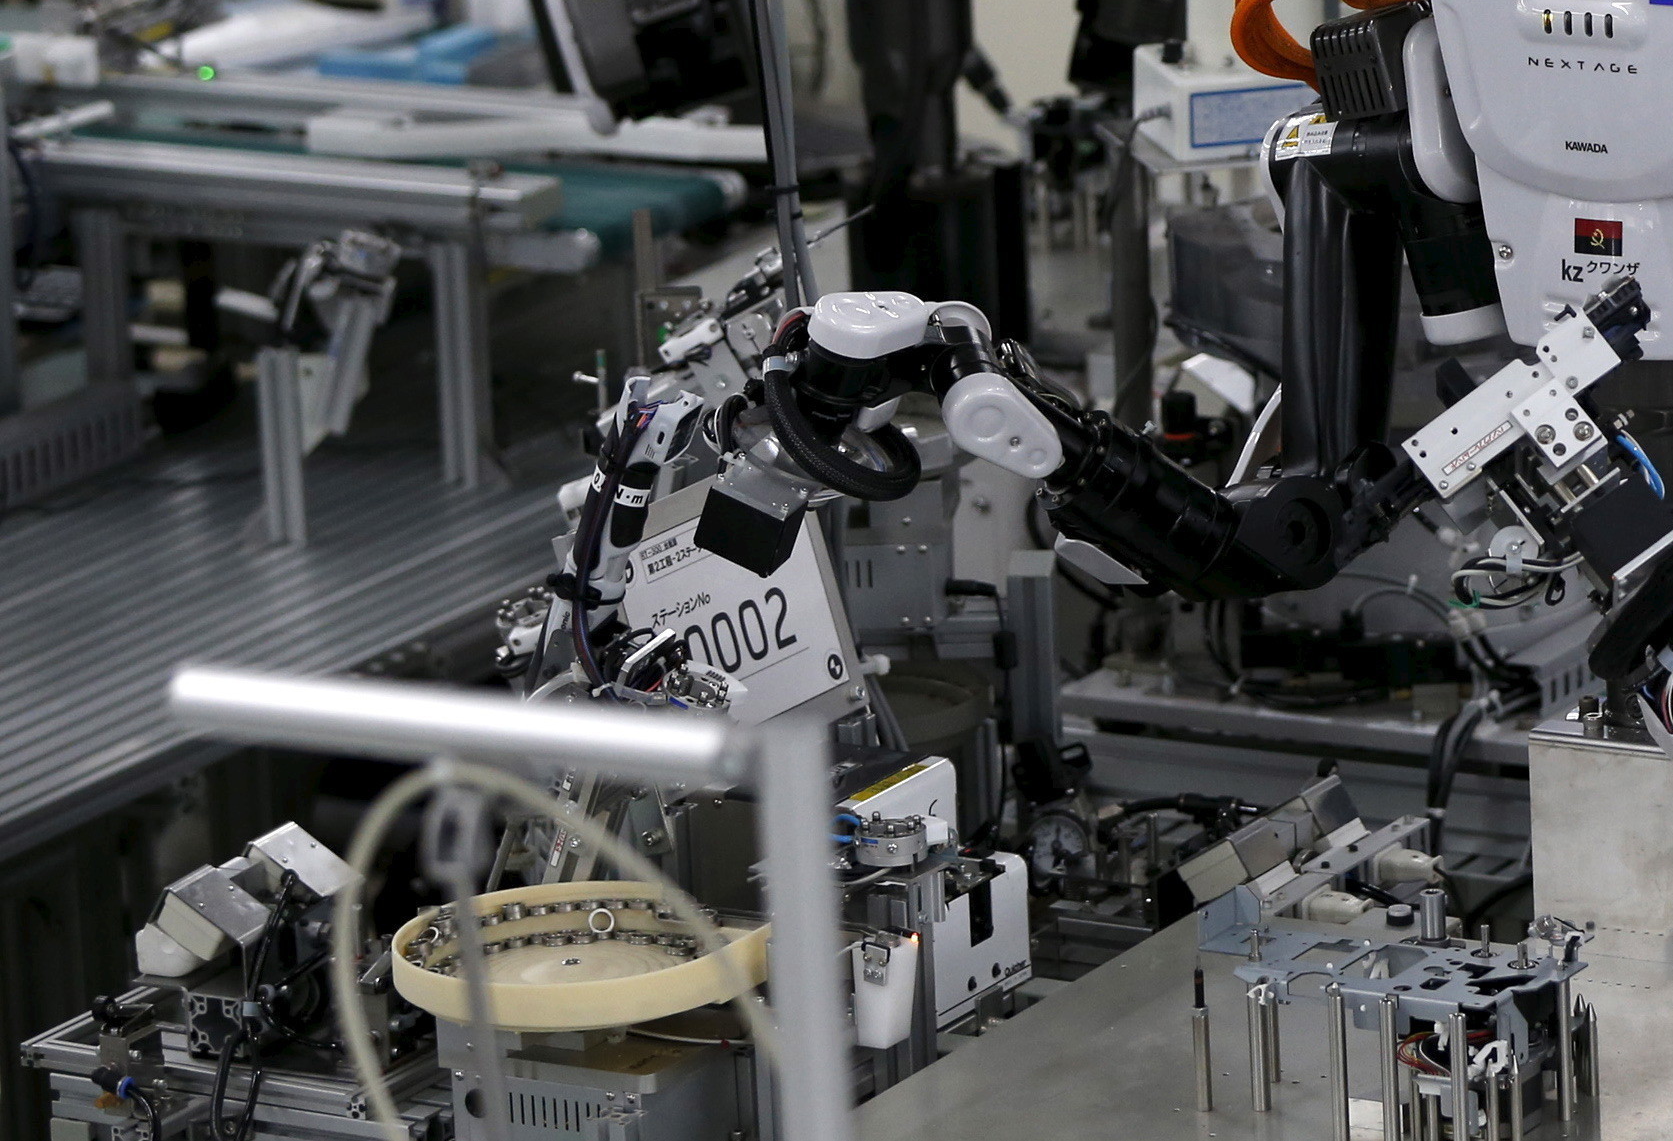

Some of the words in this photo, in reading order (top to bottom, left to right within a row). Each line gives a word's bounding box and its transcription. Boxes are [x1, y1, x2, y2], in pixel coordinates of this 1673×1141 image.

[1528, 56, 1638, 74] NEXTAGE
[1565, 140, 1609, 154] KAWADA
[1561, 258, 1584, 282] kz
[1587, 260, 1640, 275] クワンザ
